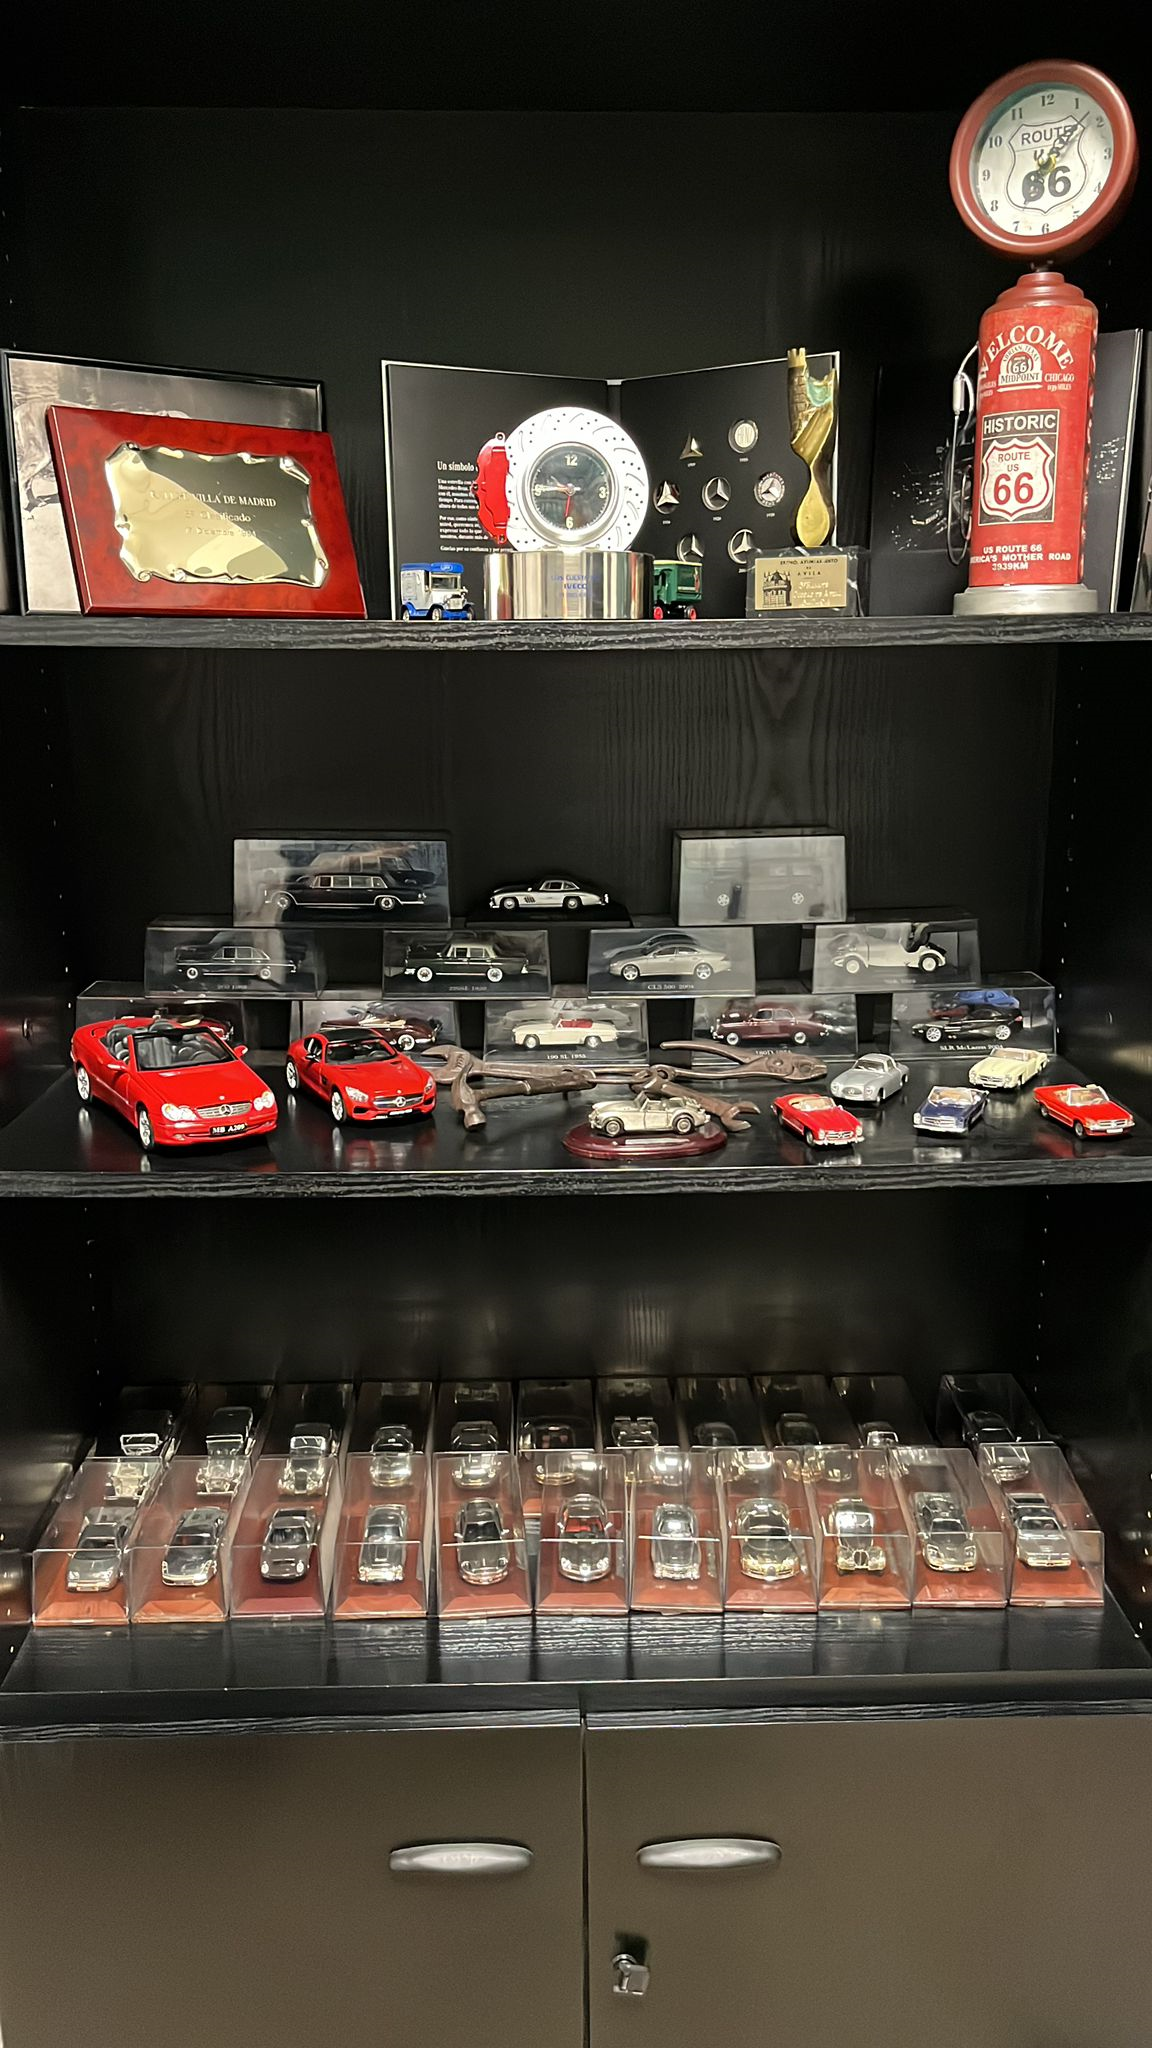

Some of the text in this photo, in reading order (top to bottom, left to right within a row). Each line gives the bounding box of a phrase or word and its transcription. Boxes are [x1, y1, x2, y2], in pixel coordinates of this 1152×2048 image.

[1040, 94, 1055, 107] 12
[1074, 98, 1080, 110] 1
[1011, 108, 1024, 121] 11
[1096, 117, 1105, 128] 2
[988, 135, 1003, 149] 10
[1103, 148, 1112, 160] 3
[982, 169, 991, 181] 9
[990, 200, 999, 212] 8
[1012, 221, 1020, 233] 7
[1041, 223, 1050, 235] 6
[1012, 361, 1027, 373] 66
[1000, 372, 1041, 384] MIDPOINT
[1044, 373, 1075, 383] CHICAGO
[984, 414, 1056, 435] HISTORIC
[565, 455, 578, 466] 12
[997, 451, 1031, 463] ROUTE
[437, 461, 447, 470] Un
[449, 461, 474, 471] símbolo
[1007, 464, 1019, 472] US
[534, 484, 543, 496] 9
[599, 487, 607, 499] 3
[993, 472, 1034, 505] 66
[223, 495, 237, 504] DE
[239, 496, 276, 507] MADRID
[566, 516, 573, 529] 6
[983, 544, 1042, 555] US ROUTE 66
[1002, 553, 1043, 561] MOTHER
